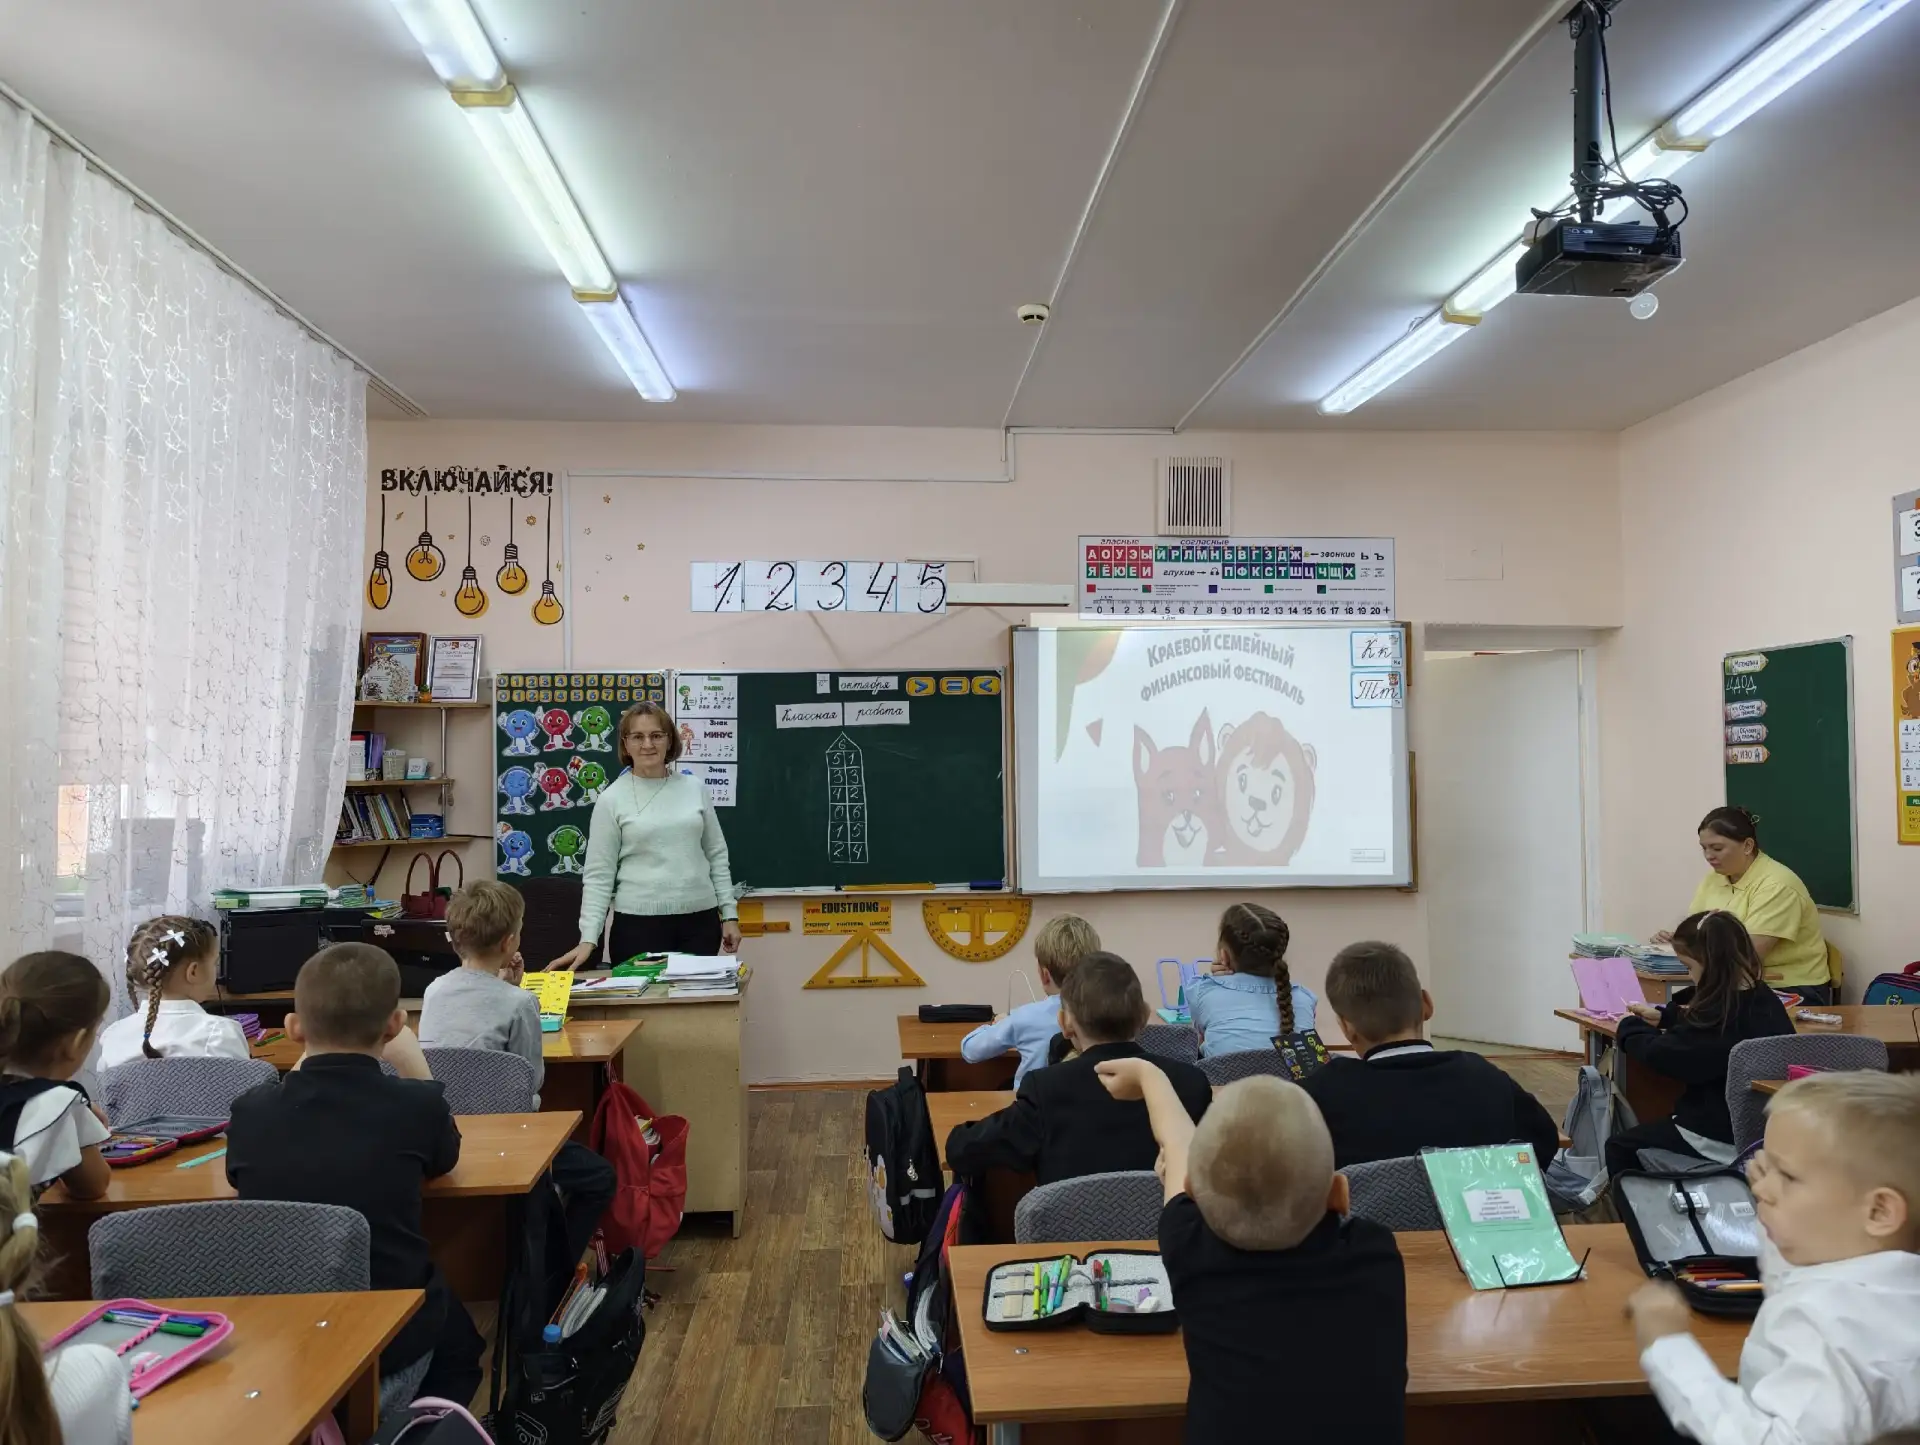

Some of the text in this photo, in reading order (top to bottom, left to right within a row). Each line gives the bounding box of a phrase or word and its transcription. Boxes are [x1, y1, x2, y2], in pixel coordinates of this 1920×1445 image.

[381, 466, 553, 496] ВКЛЮЧАЙСЯ!
[1163, 569, 1195, 577] глухие
[715, 562, 946, 613] 1 2 3 4 5
[1097, 606, 1102, 614] 0
[1110, 606, 1115, 614] 1
[1124, 606, 1130, 614] 2
[1138, 606, 1145, 614] 3
[1151, 606, 1157, 614] 4
[1165, 606, 1171, 614] 5
[1179, 606, 1185, 614] 6
[1193, 606, 1198, 614] 7
[1206, 606, 1212, 614] 8
[1221, 606, 1227, 614] 9
[1232, 606, 1242, 614] 10
[1247, 606, 1256, 614] 11
[1260, 606, 1269, 614] 12
[1274, 606, 1283, 614] 13
[1288, 606, 1298, 614] 14
[1302, 606, 1312, 614] 15
[1316, 606, 1326, 614] 16
[1330, 606, 1339, 614] 17
[1344, 606, 1354, 614] 18
[1357, 606, 1366, 614] 19
[1370, 606, 1380, 614] 20
[1147, 628, 1294, 669] КРАЕВОЙ СЕМЕЙНЫЙ
[840, 676, 890, 695] октября
[1141, 658, 1305, 705] ФИНАНСОВЫЙ ФЕСТИВАЛЬ
[782, 703, 904, 722] Классная работа
[704, 731, 733, 739] МИНУС
[839, 739, 846, 750] 6
[832, 753, 854, 765] 5 1
[834, 769, 859, 784] 3 3
[833, 787, 859, 800] 4 2
[834, 805, 861, 819] 0 6
[832, 823, 863, 838] 1 5
[834, 842, 862, 860] 2 4
